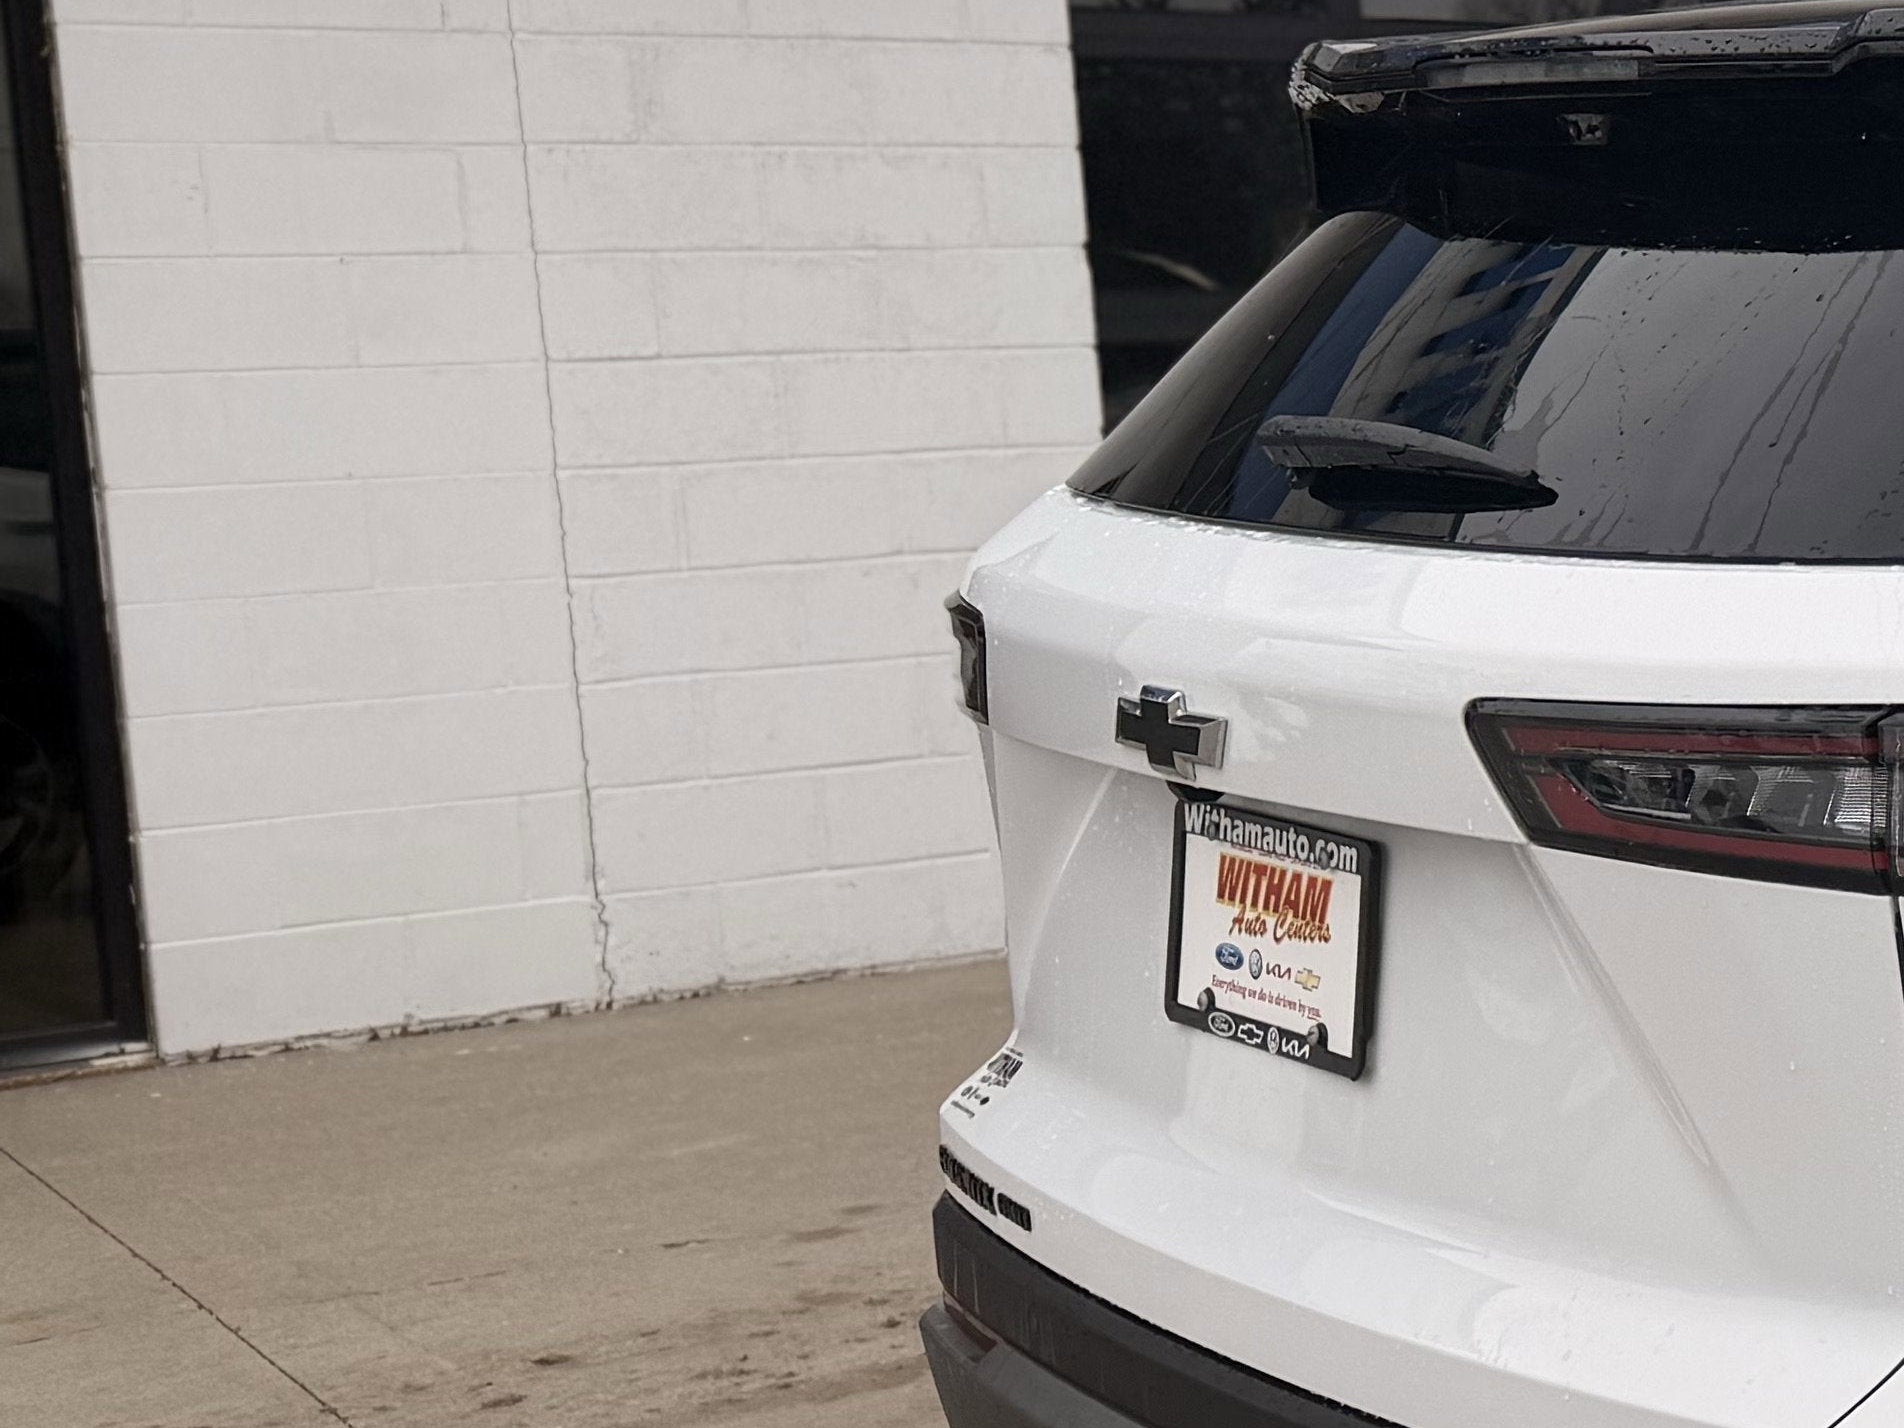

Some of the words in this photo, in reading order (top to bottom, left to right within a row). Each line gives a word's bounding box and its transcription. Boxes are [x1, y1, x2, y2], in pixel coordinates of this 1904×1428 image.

[1216, 852, 1333, 925] WITHAM
[1228, 904, 1267, 938] Auto
[1273, 906, 1331, 944] Centers
